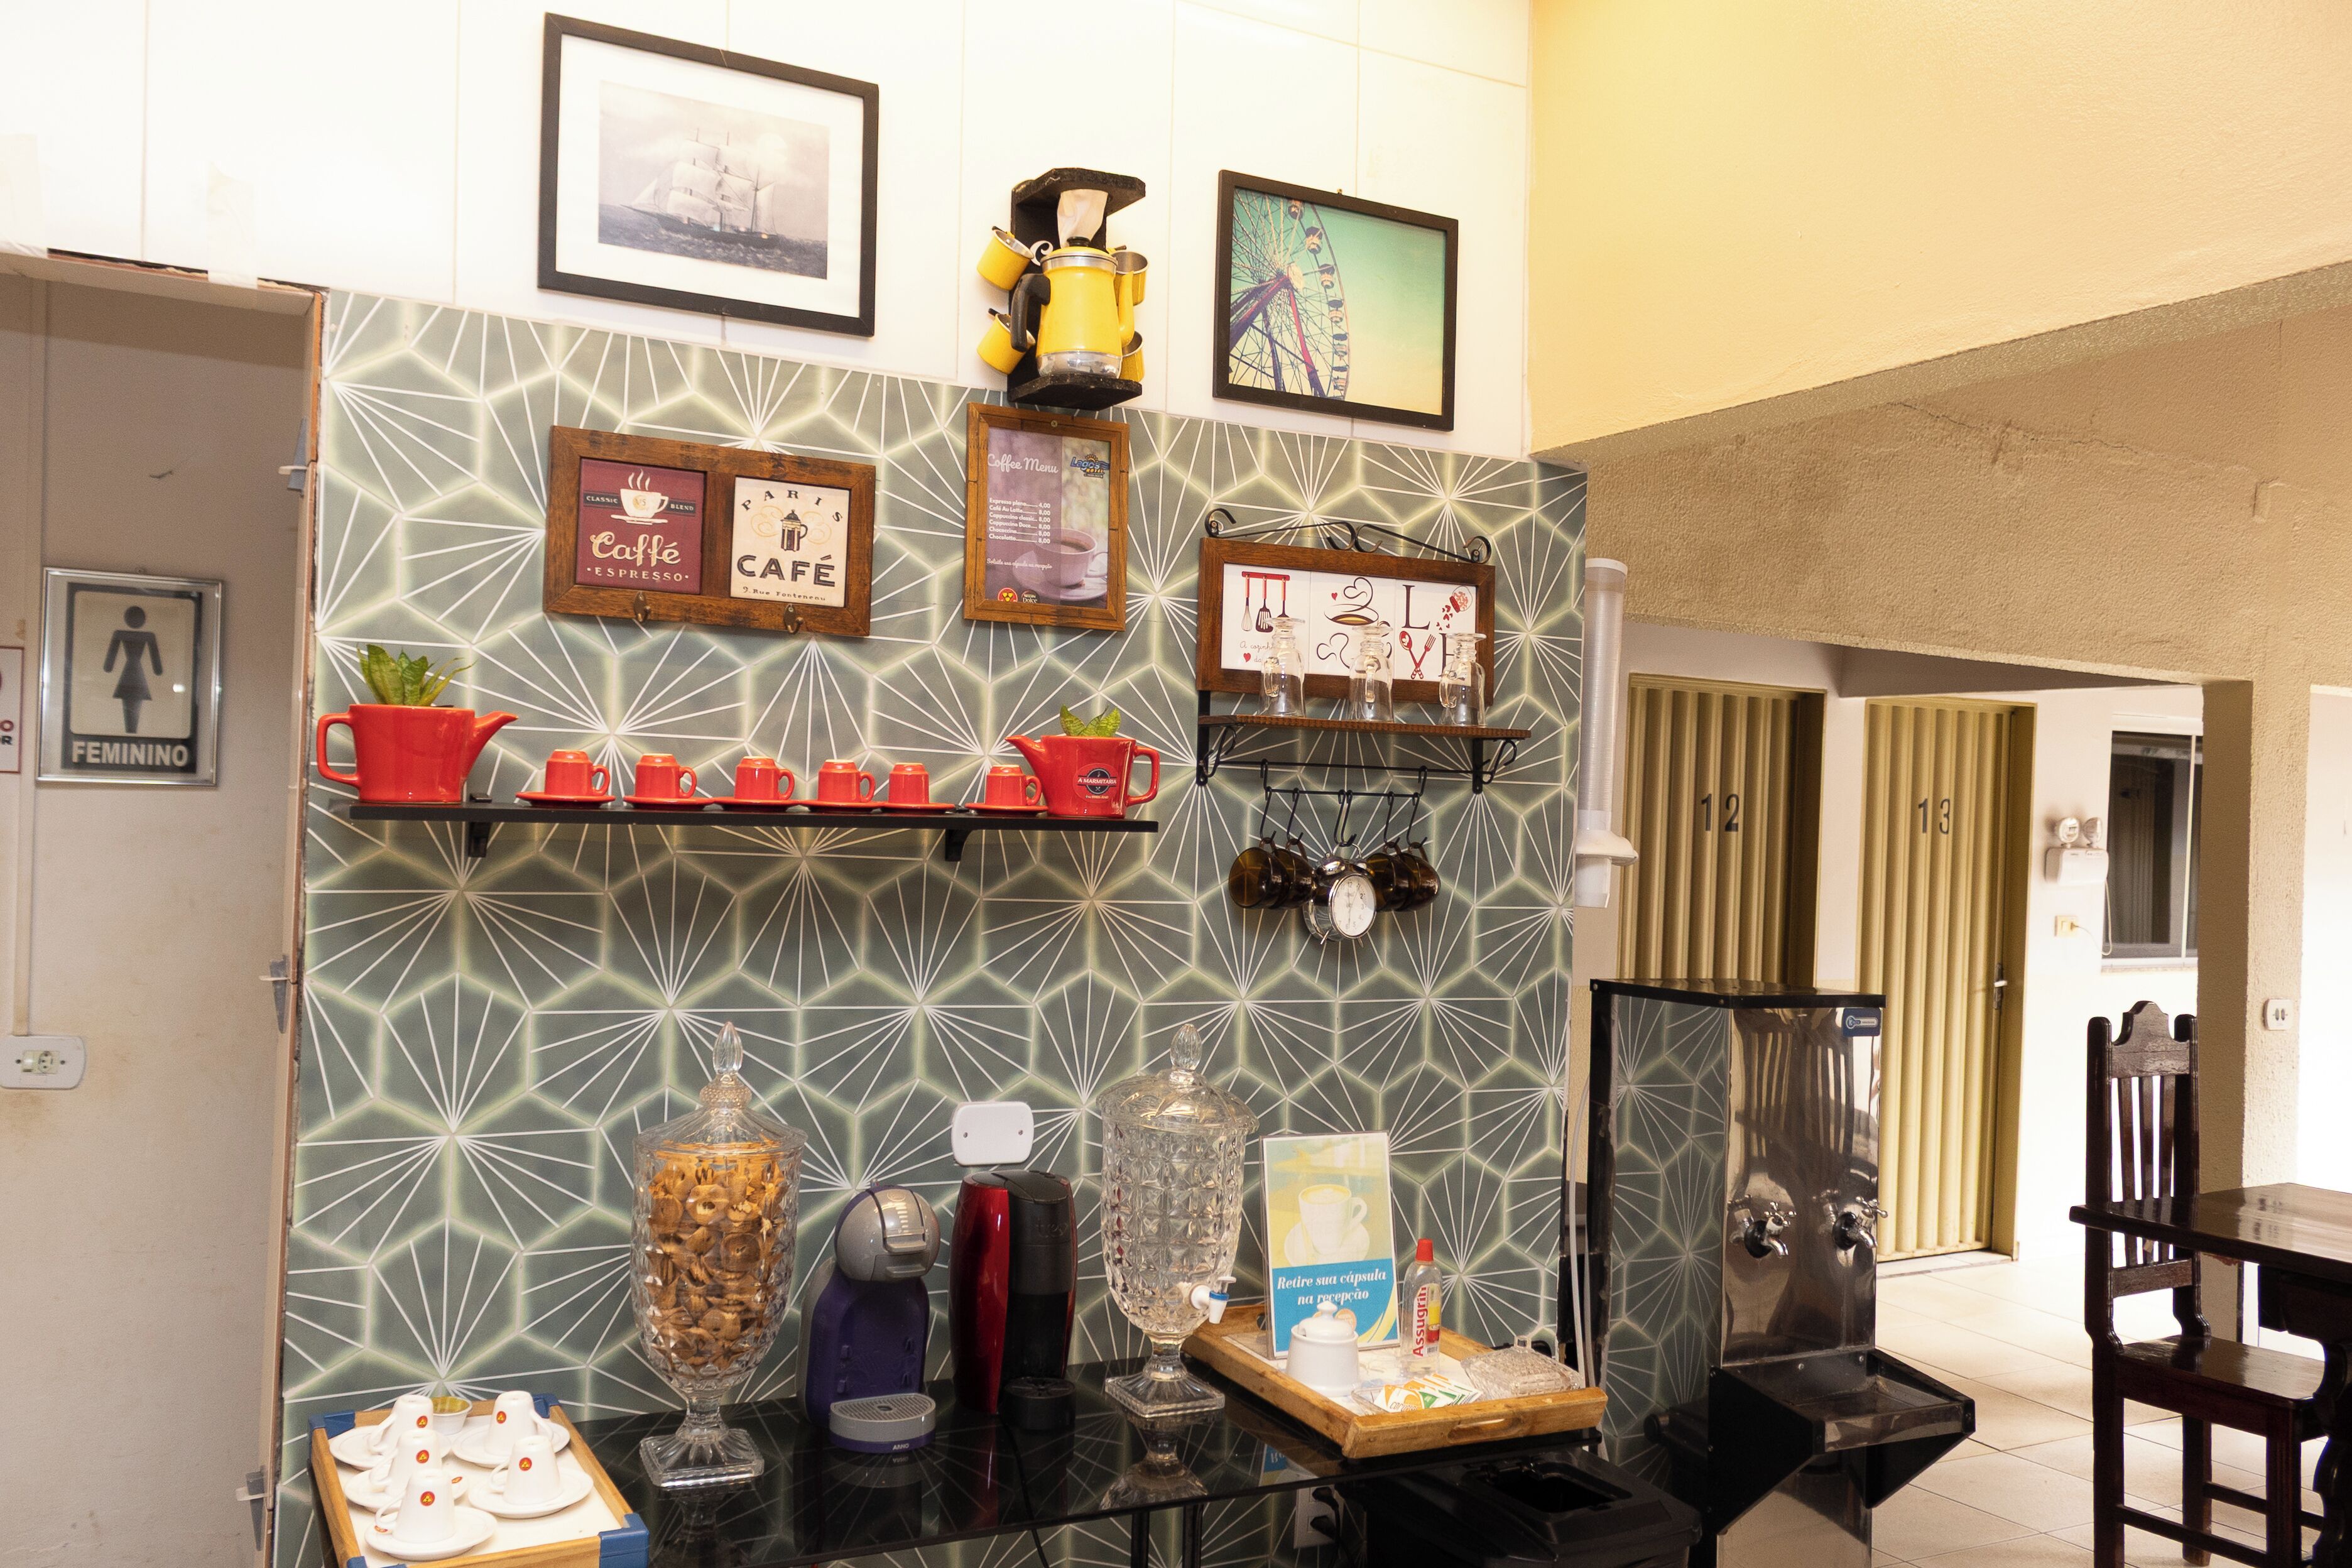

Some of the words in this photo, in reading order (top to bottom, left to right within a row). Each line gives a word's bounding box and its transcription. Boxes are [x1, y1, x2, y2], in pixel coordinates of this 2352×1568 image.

[988, 454, 1022, 473] Coffee
[1023, 457, 1059, 474] Menu
[741, 489, 843, 523] PARIS
[589, 531, 681, 567] Caffé
[737, 554, 836, 587] CAFÉ
[72, 741, 189, 767] FEMININO
[1701, 793, 1740, 832] 12
[1918, 798, 1951, 835] 13
[1277, 1276, 1313, 1290] Retire
[1315, 1276, 1337, 1286] sua
[1340, 1268, 1386, 1287] cápsula
[1297, 1295, 1314, 1305] na
[1317, 1288, 1369, 1305] recepção
[1412, 1287, 1429, 1357] Assugrin
